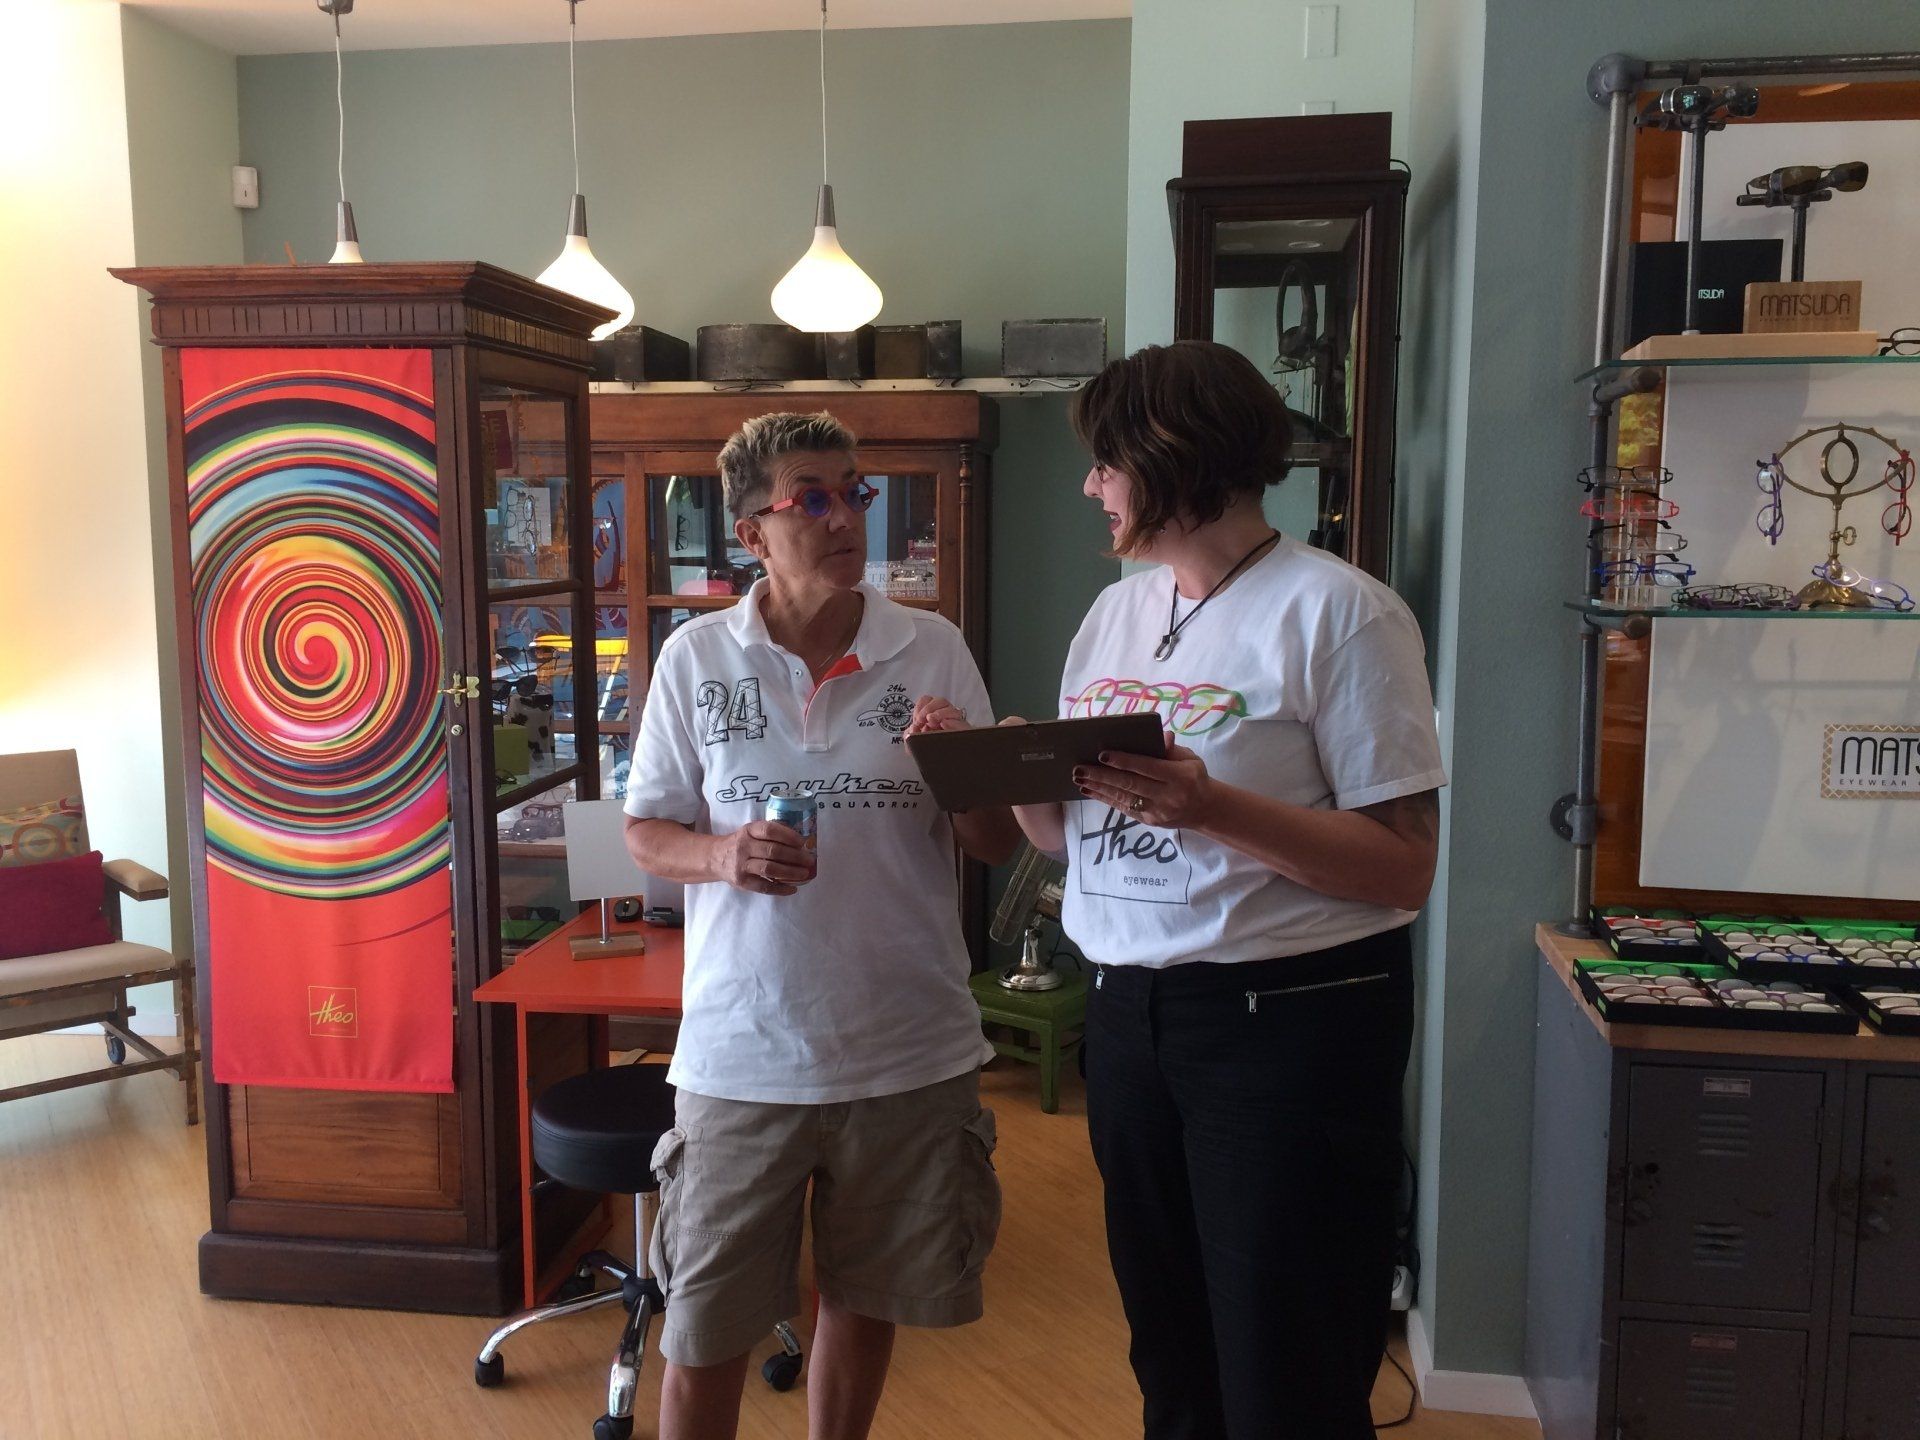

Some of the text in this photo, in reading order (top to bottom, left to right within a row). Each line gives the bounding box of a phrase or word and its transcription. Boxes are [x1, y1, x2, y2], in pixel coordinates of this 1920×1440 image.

[1759, 293, 1851, 316] MATSUDA
[697, 677, 767, 746] 24
[1081, 806, 1178, 865] theo
[1123, 875, 1168, 886] eyewear
[310, 993, 353, 1025] theo
